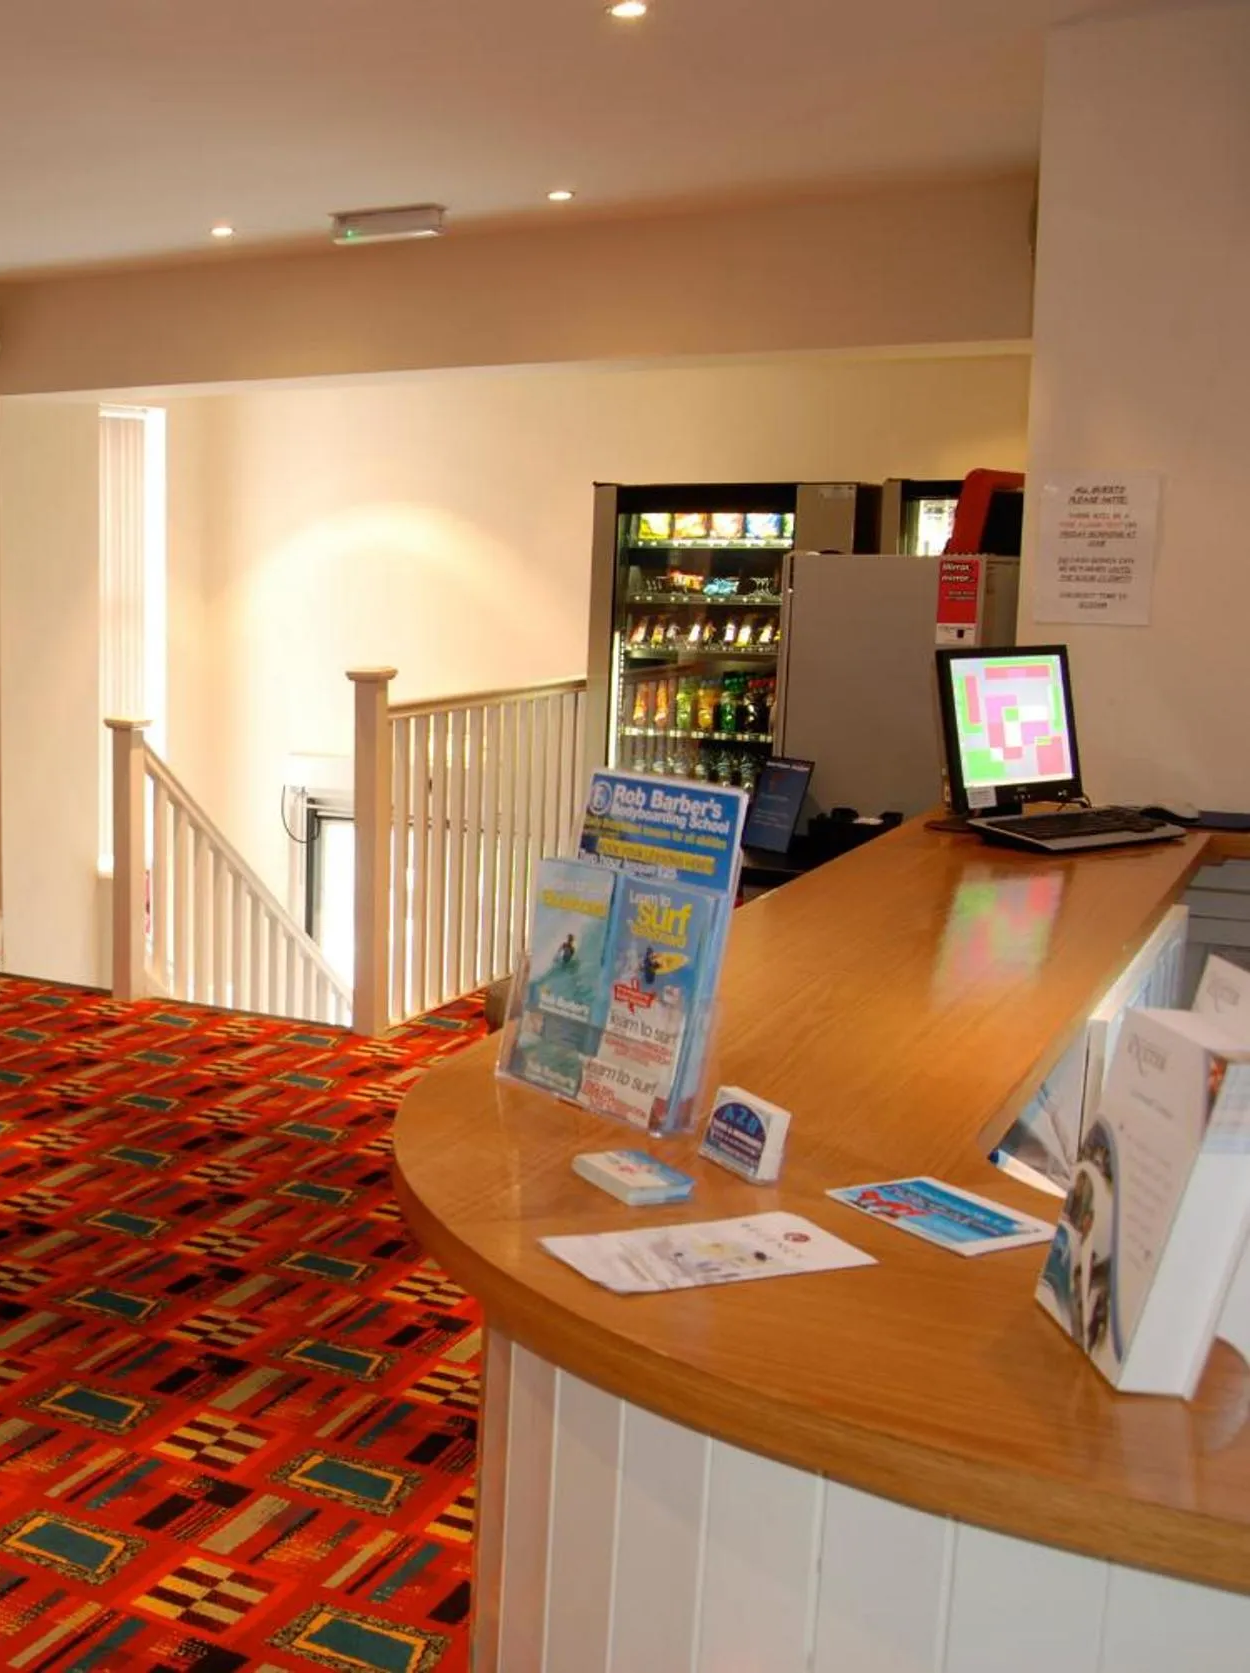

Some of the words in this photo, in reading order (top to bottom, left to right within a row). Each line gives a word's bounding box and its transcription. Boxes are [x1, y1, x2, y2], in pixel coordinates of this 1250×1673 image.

[614, 784, 646, 808] Rob
[651, 789, 723, 819] Barber's
[689, 814, 730, 835] School
[618, 1068, 631, 1085] to
